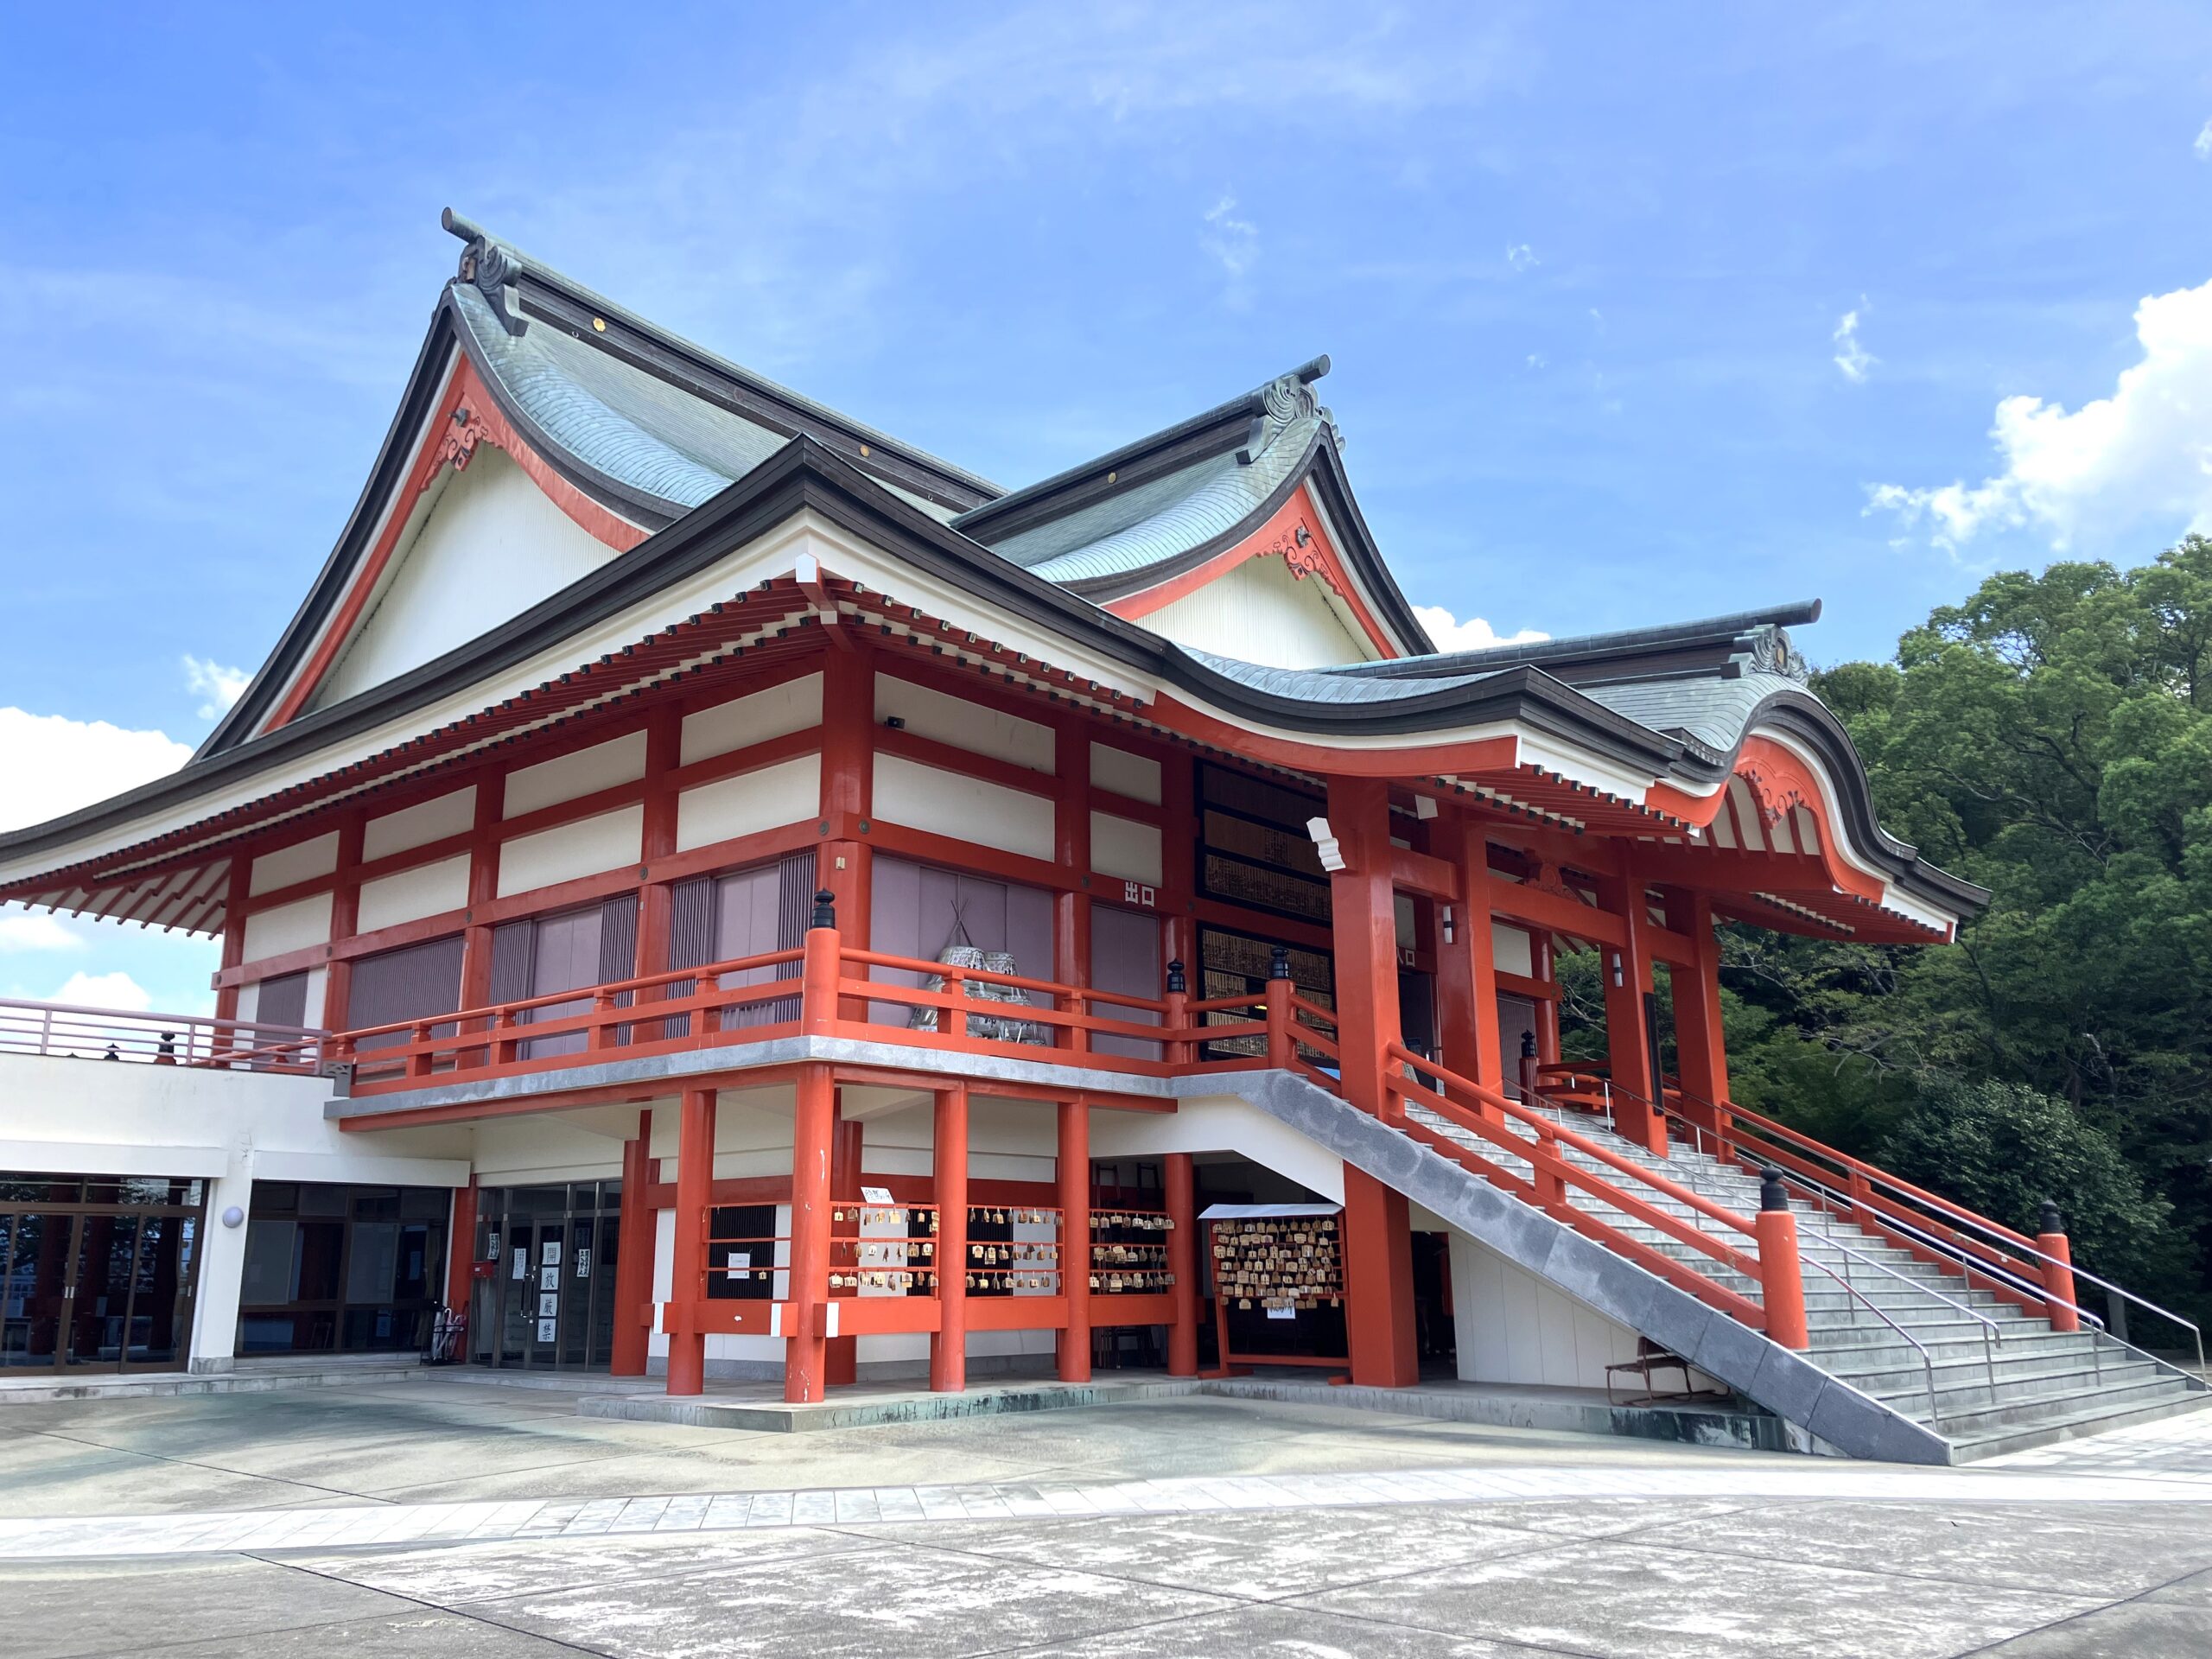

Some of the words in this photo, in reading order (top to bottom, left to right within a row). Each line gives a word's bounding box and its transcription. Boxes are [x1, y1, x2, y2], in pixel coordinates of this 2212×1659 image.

[1125, 881, 1154, 907] 出口
[542, 1247, 557, 1340] 開放厳禁
